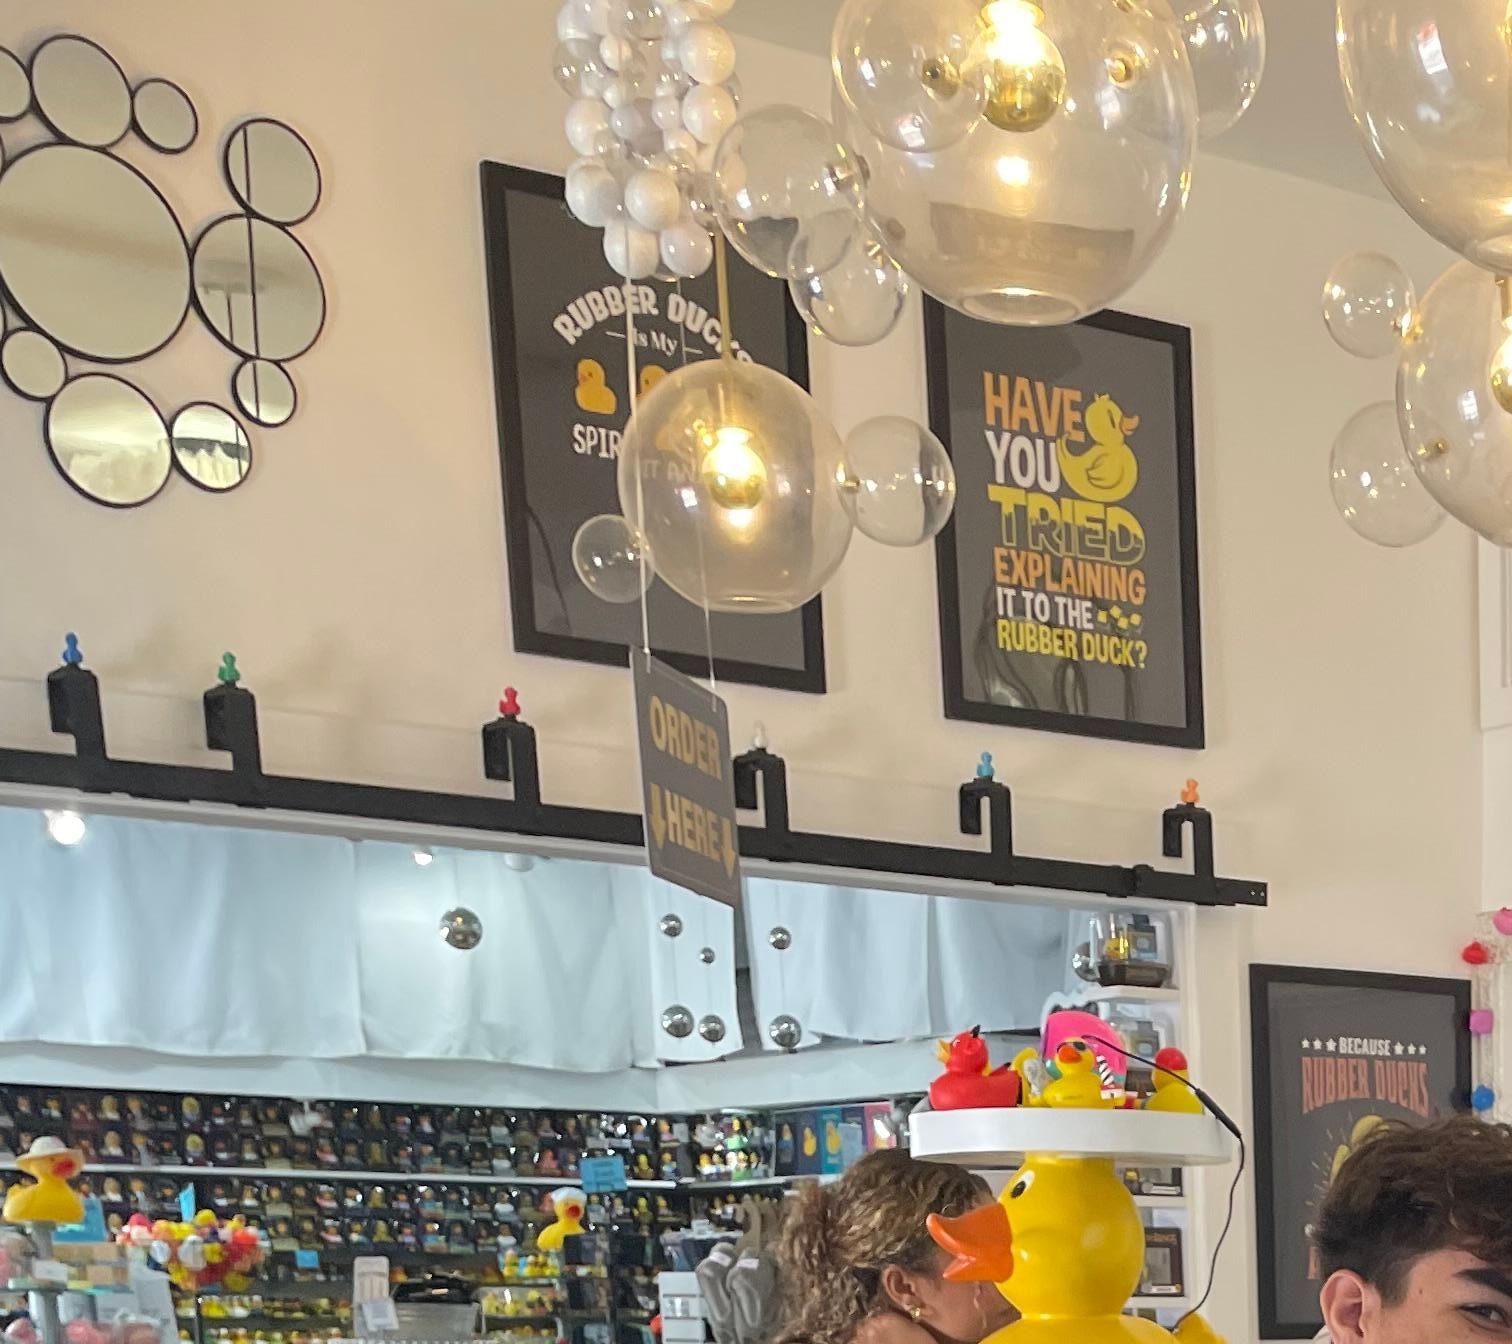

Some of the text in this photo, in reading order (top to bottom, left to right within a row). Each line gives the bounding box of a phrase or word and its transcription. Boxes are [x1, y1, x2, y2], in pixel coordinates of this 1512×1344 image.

[553, 284, 659, 346] RUBBER
[650, 330, 677, 357] My
[984, 371, 1085, 442] HAVE
[984, 430, 1061, 493] YOU
[988, 484, 1146, 565] TRIED
[994, 547, 1146, 606] EXPLAINING
[996, 586, 1094, 630] IT TO THE
[997, 618, 1148, 669] RUBBER DUCK?
[650, 695, 723, 781] ORDER
[664, 788, 721, 862] HERE
[1338, 1036, 1392, 1057] BECAUSE
[1302, 1056, 1430, 1119] RUBBER DUCKS
